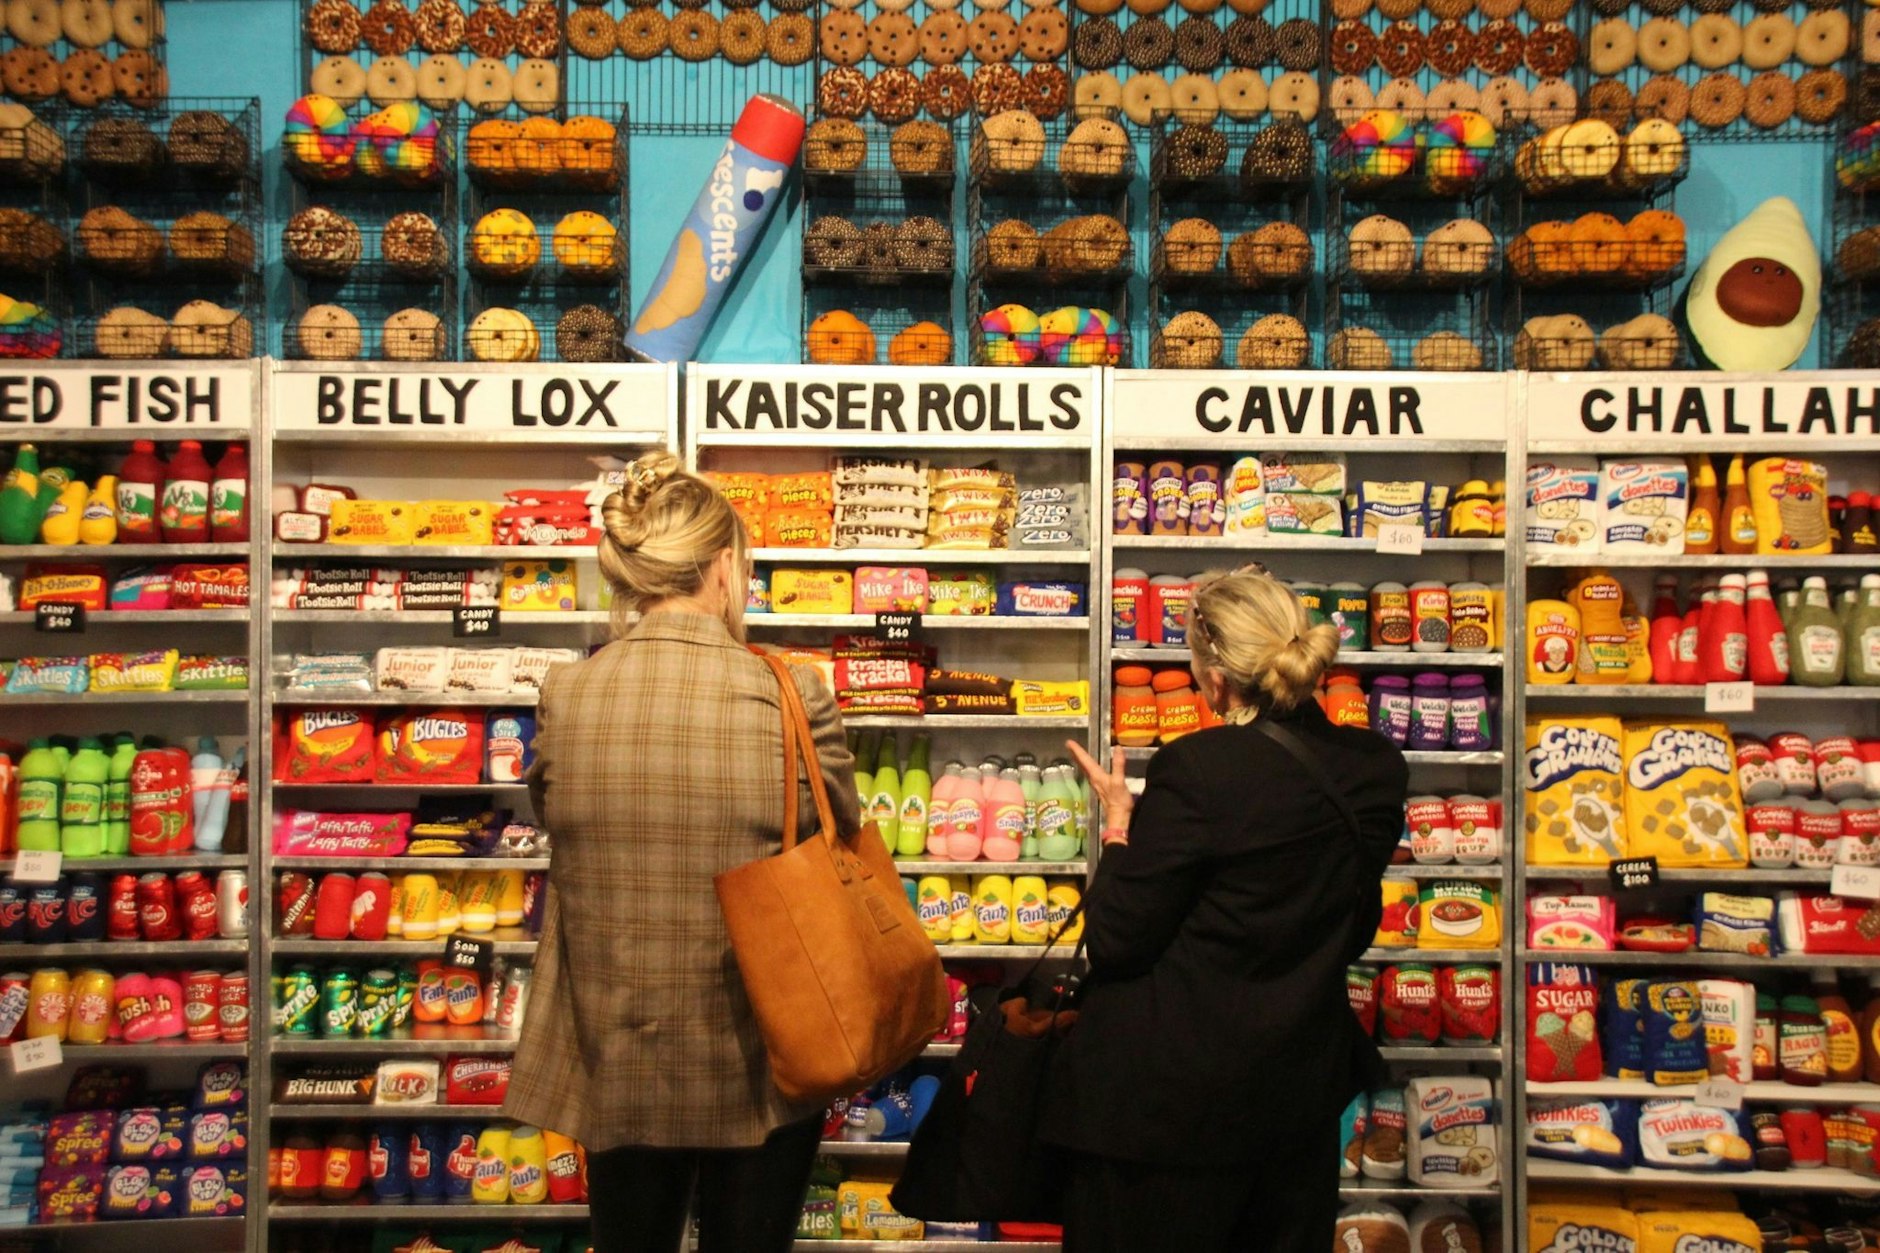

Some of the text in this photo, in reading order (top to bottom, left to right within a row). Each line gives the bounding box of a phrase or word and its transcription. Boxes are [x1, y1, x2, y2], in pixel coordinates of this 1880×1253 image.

[90, 376, 220, 426] FISH
[318, 376, 621, 427] BELLY LOX
[706, 379, 1082, 432] KAISER ROLLS
[1196, 386, 1424, 435] CAVIAR
[1581, 386, 1880, 434] CHALLAH
[1532, 479, 1588, 503] donettes
[1620, 478, 1678, 499] donettes
[349, 513, 384, 523] SUGAR
[430, 514, 466, 523] SUGAR
[313, 569, 370, 581] Tootsie Roll
[175, 581, 196, 594] HOT
[200, 582, 250, 596] TAMALES
[308, 581, 363, 594] Tootsie Roll
[403, 581, 462, 593] Tootsie Roll
[860, 579, 924, 599] Mike Ike
[929, 584, 988, 600] Mike Ike
[1020, 593, 1070, 609] CRUNCH
[40, 604, 75, 615] CANDY
[461, 609, 493, 619] CANDY
[49, 617, 72, 627] $40
[466, 621, 489, 632] $40
[880, 615, 913, 625] CANDY
[888, 627, 909, 639] $40
[99, 669, 164, 687] Skittles
[957, 694, 1008, 707] AVENUE
[1718, 689, 1743, 701] $60
[304, 711, 360, 736] BUGLES
[413, 717, 467, 742] BUGLES
[1541, 725, 1619, 752] GOLDEN
[1651, 727, 1728, 753] GOLDEN
[901, 826, 921, 834] LIME
[1616, 862, 1652, 874] CEREAL
[1623, 874, 1650, 887] $100
[454, 940, 480, 953] SODA
[456, 953, 475, 965] $50
[1396, 983, 1436, 998] Hunt's
[1455, 982, 1493, 998] Hunt's
[1536, 989, 1593, 1008] SUGAR
[287, 1077, 357, 1095] BIG HUNK
[1432, 1106, 1485, 1130] donettes
[1526, 1106, 1600, 1124] Twinkies
[124, 1122, 157, 1136] BLOW
[196, 1122, 226, 1136] BLOW
[1645, 1112, 1725, 1137] Twinkies
[130, 1132, 148, 1142] POP
[55, 1138, 102, 1152] Spree
[116, 1176, 149, 1190] BLOW
[192, 1181, 220, 1193] BLOW
[50, 1192, 96, 1209] Spree
